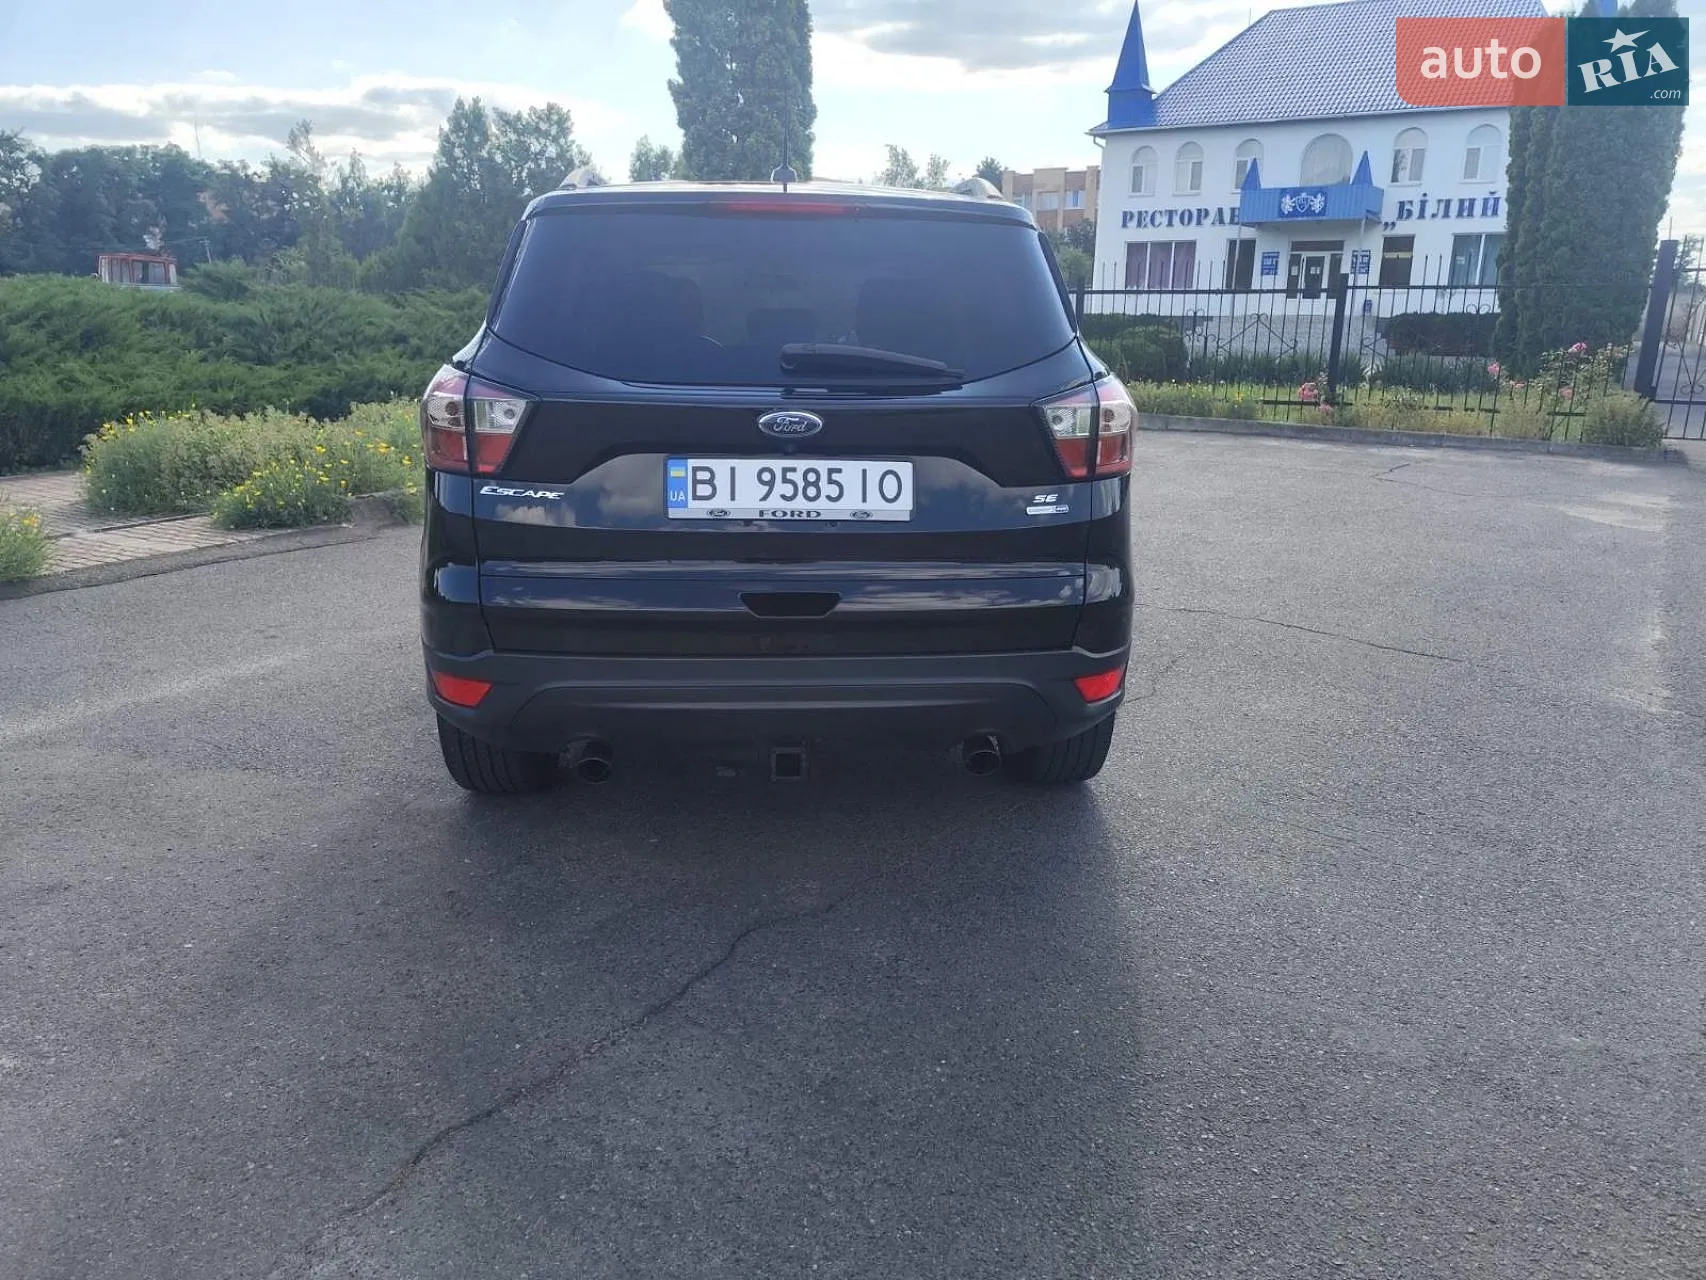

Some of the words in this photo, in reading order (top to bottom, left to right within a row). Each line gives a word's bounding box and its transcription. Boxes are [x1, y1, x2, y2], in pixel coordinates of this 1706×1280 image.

[773, 416, 808, 432] Ford
[691, 465, 736, 501] BI
[756, 466, 845, 502] 9585
[861, 467, 903, 504] IO
[480, 486, 565, 500] ESCAPE
[670, 489, 686, 502] UA
[1032, 494, 1059, 503] SE
[758, 509, 822, 519] FORD
